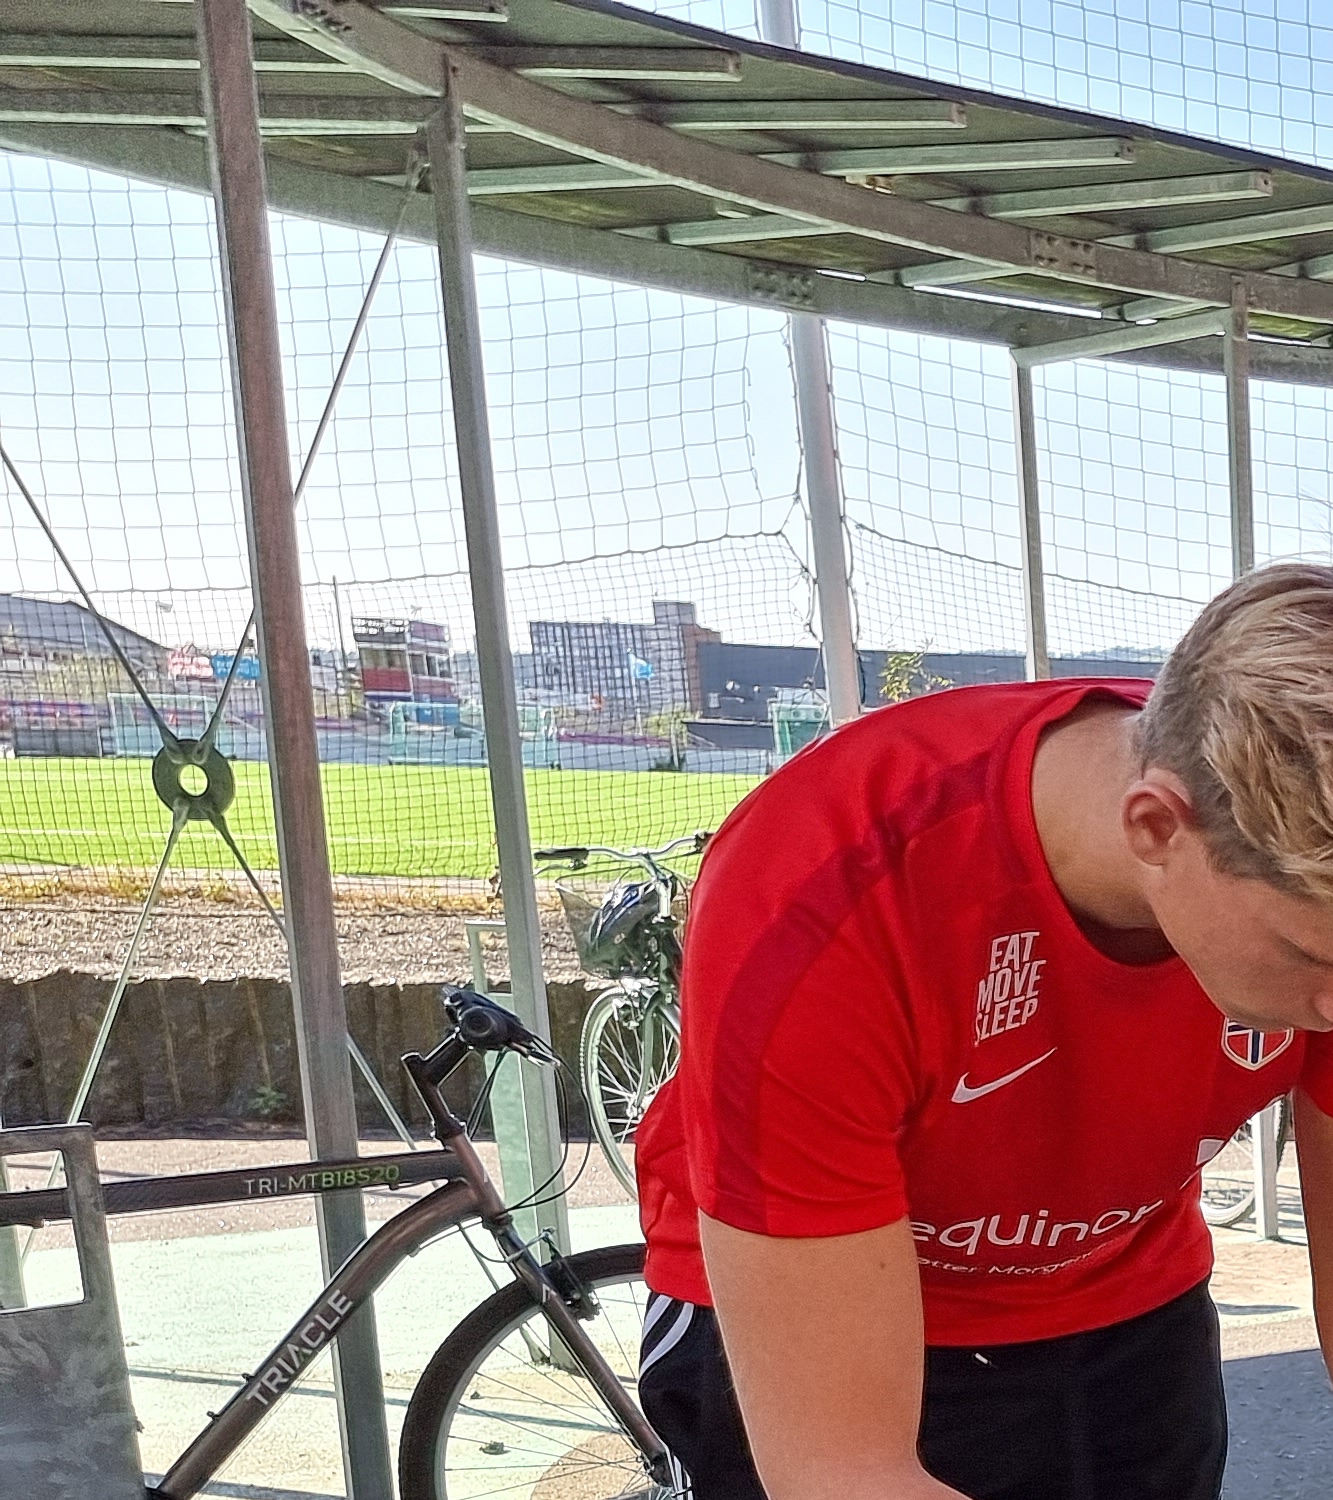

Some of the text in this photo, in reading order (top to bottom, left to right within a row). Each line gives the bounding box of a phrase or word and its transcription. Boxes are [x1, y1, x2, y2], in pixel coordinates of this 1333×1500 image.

[989, 930, 1041, 972] EAT
[977, 959, 1048, 1014] MOVE
[974, 997, 1039, 1048] SLEEP
[243, 1164, 400, 1196] TRI-MTB18S20
[909, 1199, 1164, 1256] equinor
[246, 1288, 354, 1406] TRIACLE
